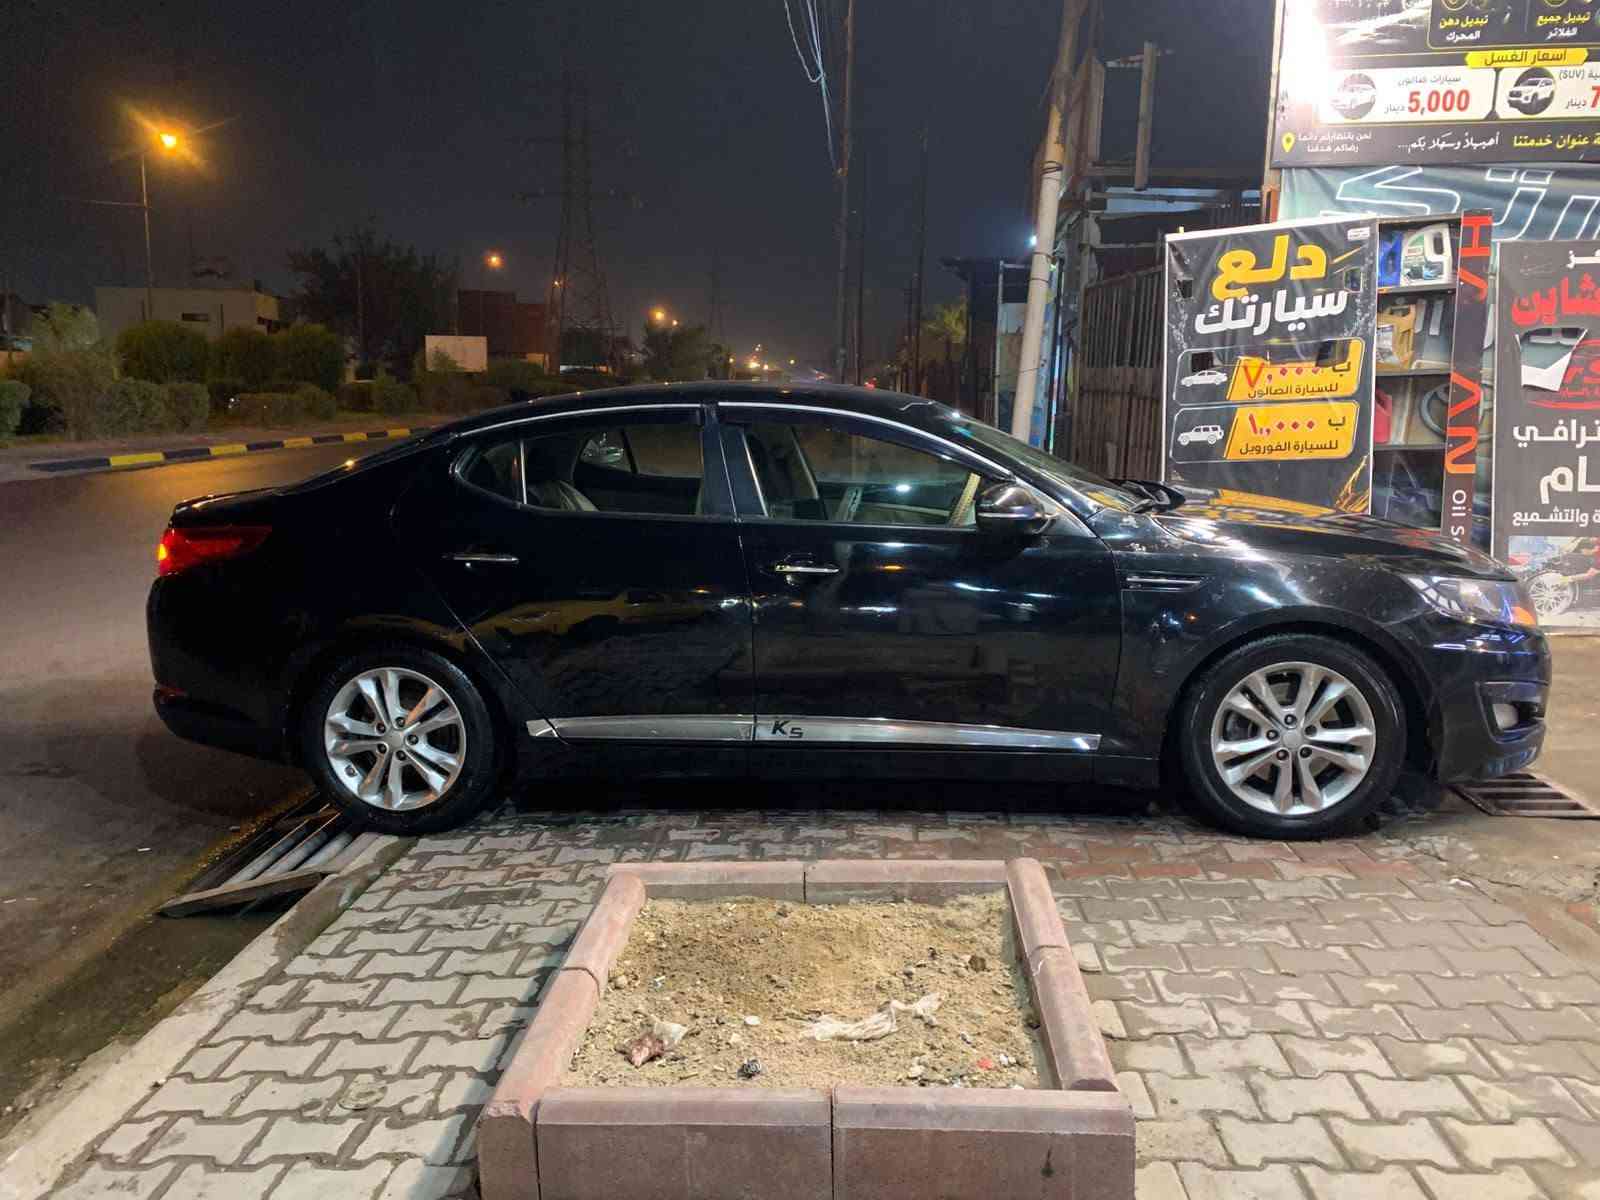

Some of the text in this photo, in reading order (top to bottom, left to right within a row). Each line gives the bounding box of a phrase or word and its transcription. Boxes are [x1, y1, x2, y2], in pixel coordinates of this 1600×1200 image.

[1461, 15, 1488, 28] تبديل
[1536, 12, 1591, 27] تبديل جميع
[1446, 30, 1480, 42] المحرك
[1545, 26, 1577, 40] الفلاتر
[1484, 52, 1527, 66] الغسل
[1559, 69, 1585, 80] (SUV)
[1384, 89, 1470, 115] 5,000 دينار
[1566, 97, 1587, 109] دينار
[1513, 134, 1552, 147] خدمتنا
[1556, 134, 1590, 149] عنوان
[1212, 235, 1327, 299] دلع
[1195, 289, 1348, 336] سيارتك
[1295, 382, 1338, 396] للسيارة
[1328, 416, 1346, 431] ب
[1293, 440, 1338, 454] للسيارة
[1451, 489, 1467, 517] Oil
[1512, 505, 1589, 527] والتشميع
